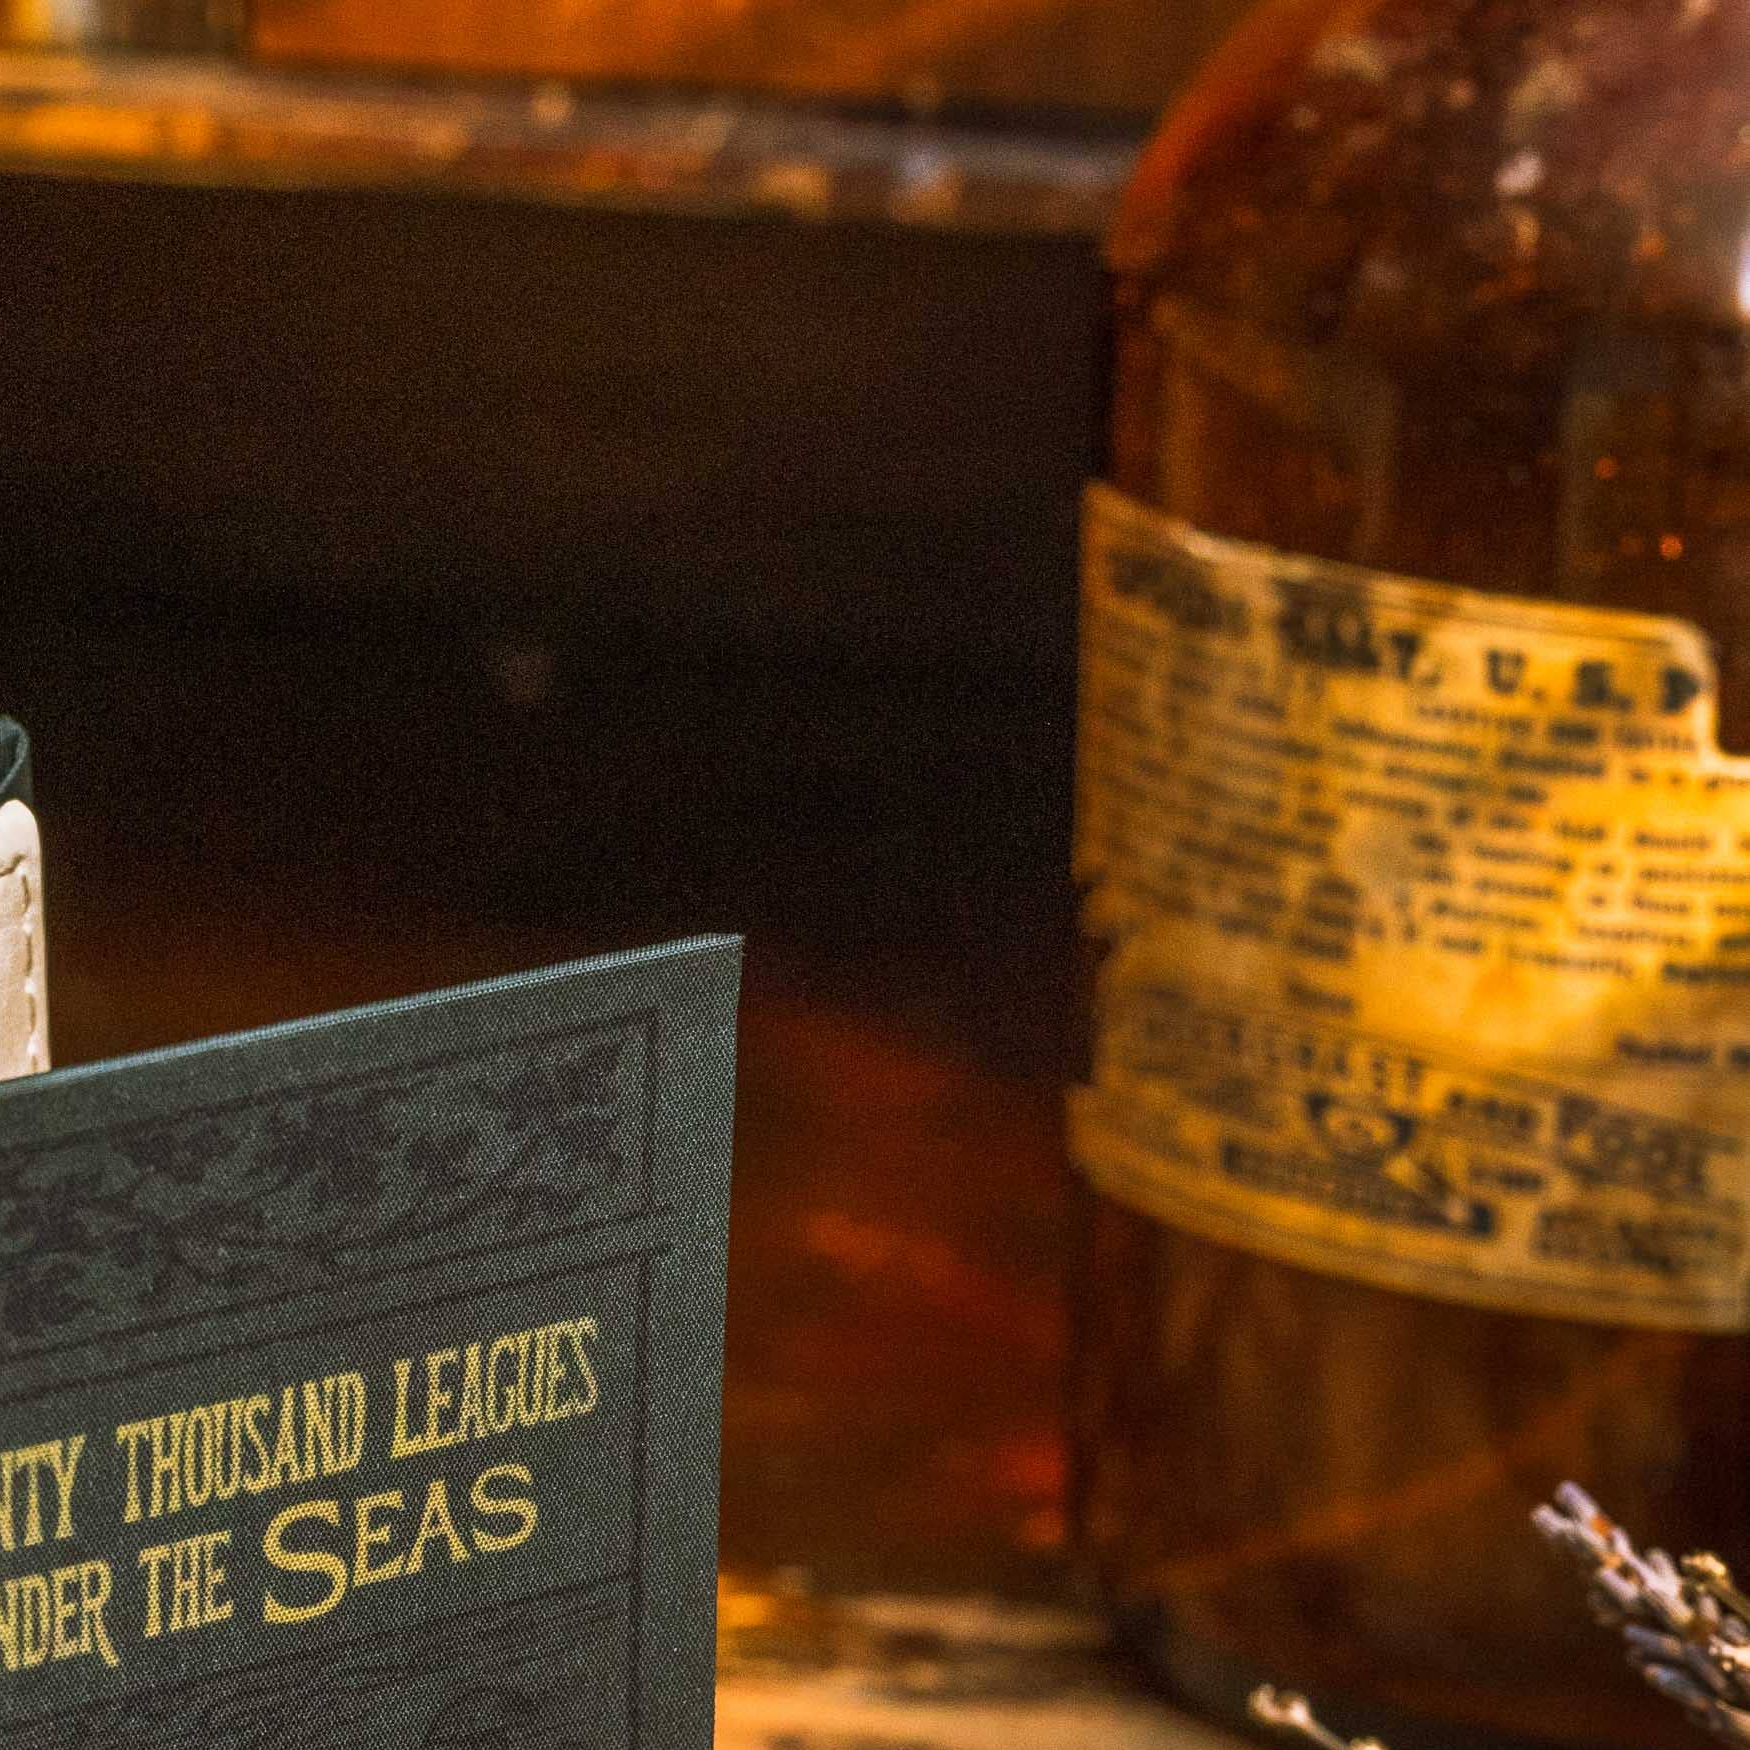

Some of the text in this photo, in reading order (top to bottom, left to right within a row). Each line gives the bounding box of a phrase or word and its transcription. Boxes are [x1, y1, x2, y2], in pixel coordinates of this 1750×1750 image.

[117, 1371, 367, 1523] THOUSAND
[390, 1316, 600, 1460] LEAGUES
[139, 1530, 234, 1638] THE
